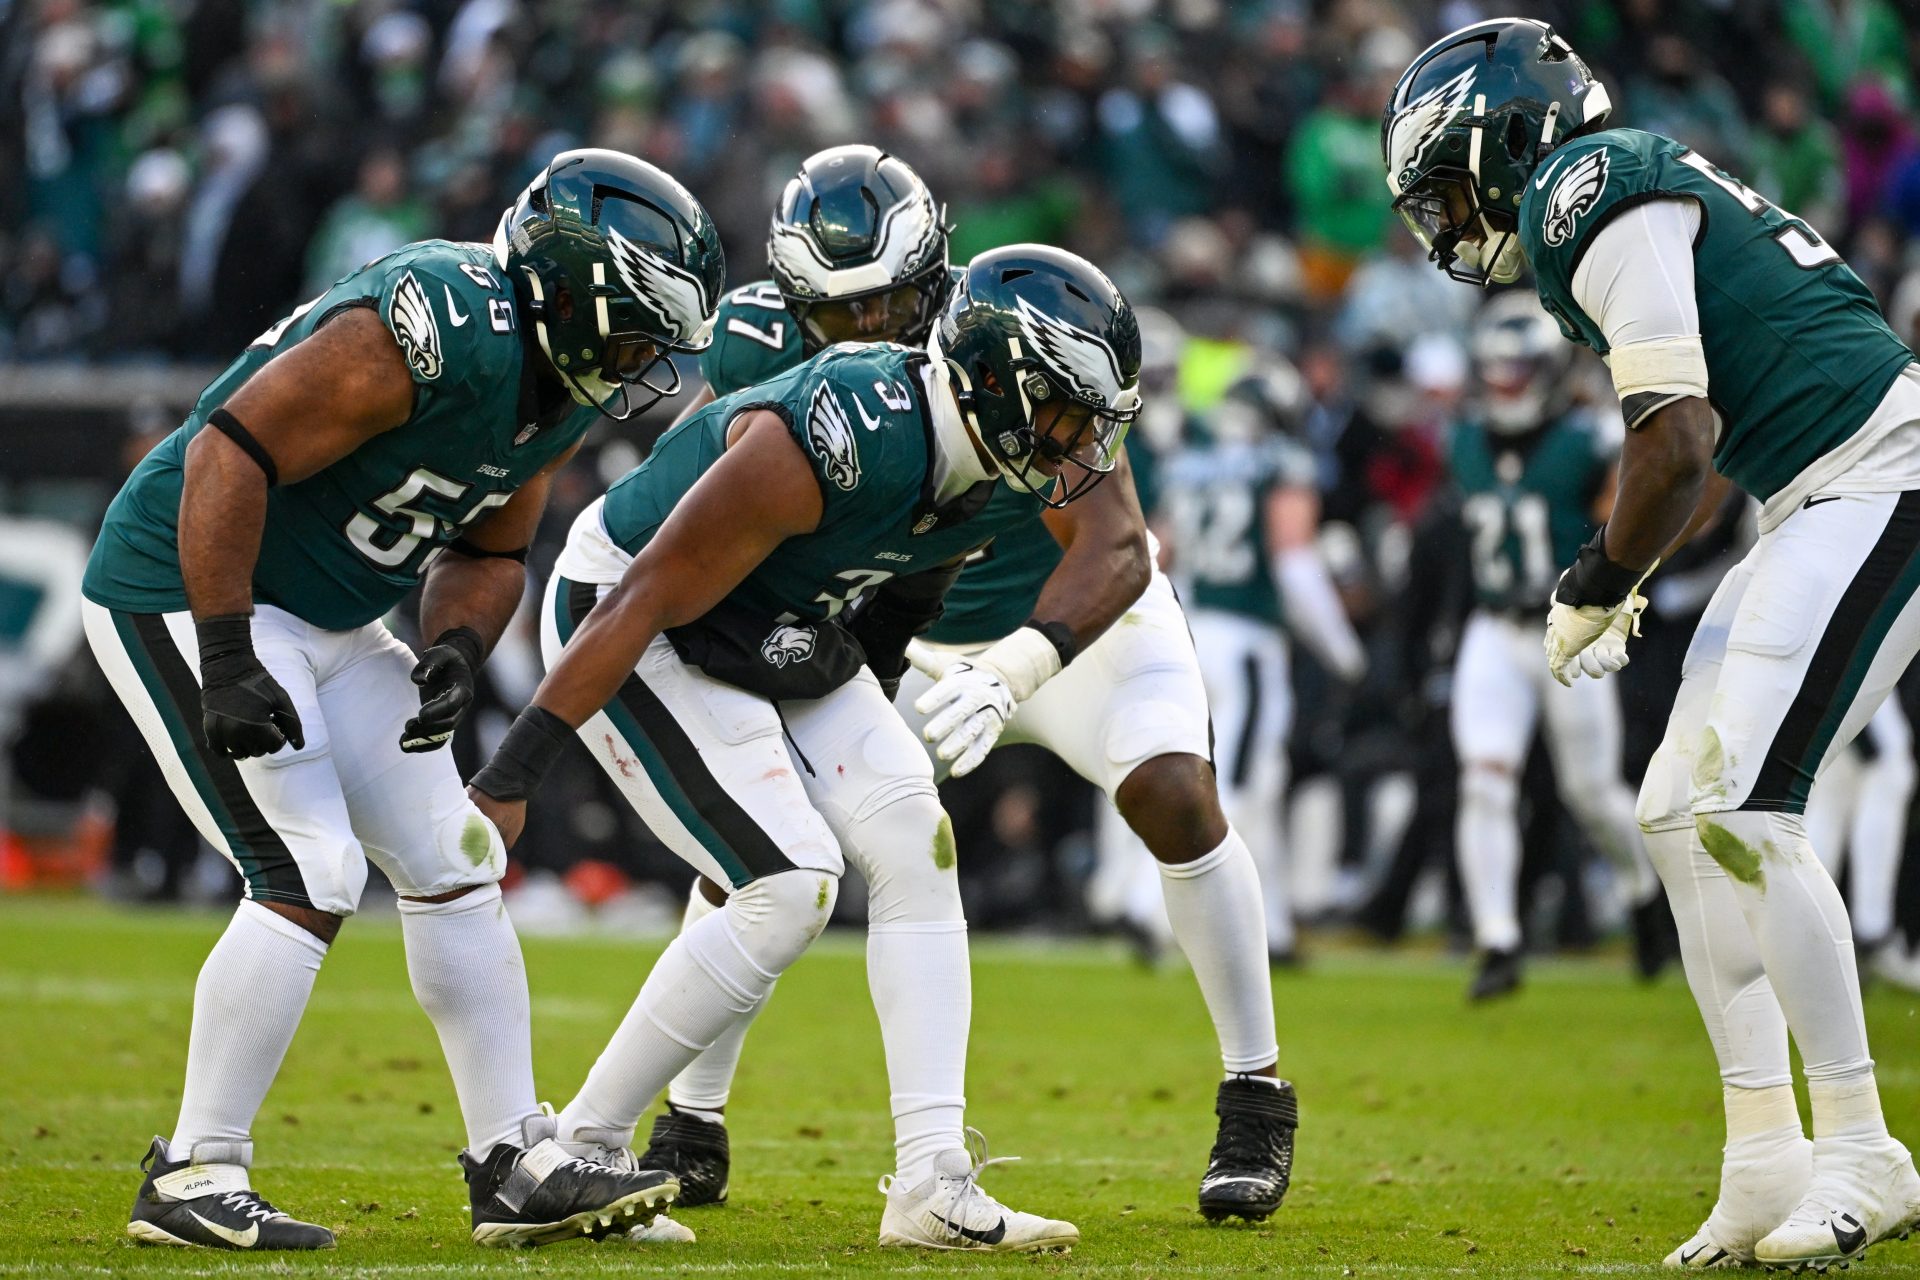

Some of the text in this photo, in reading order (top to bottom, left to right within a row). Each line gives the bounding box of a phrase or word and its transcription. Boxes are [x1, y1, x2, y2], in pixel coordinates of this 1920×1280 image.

[459, 263, 516, 332] 55
[727, 286, 787, 349] 97
[874, 380, 912, 411] 3
[476, 463, 511, 478] EAGLES
[183, 1179, 215, 1192] ALPHA
